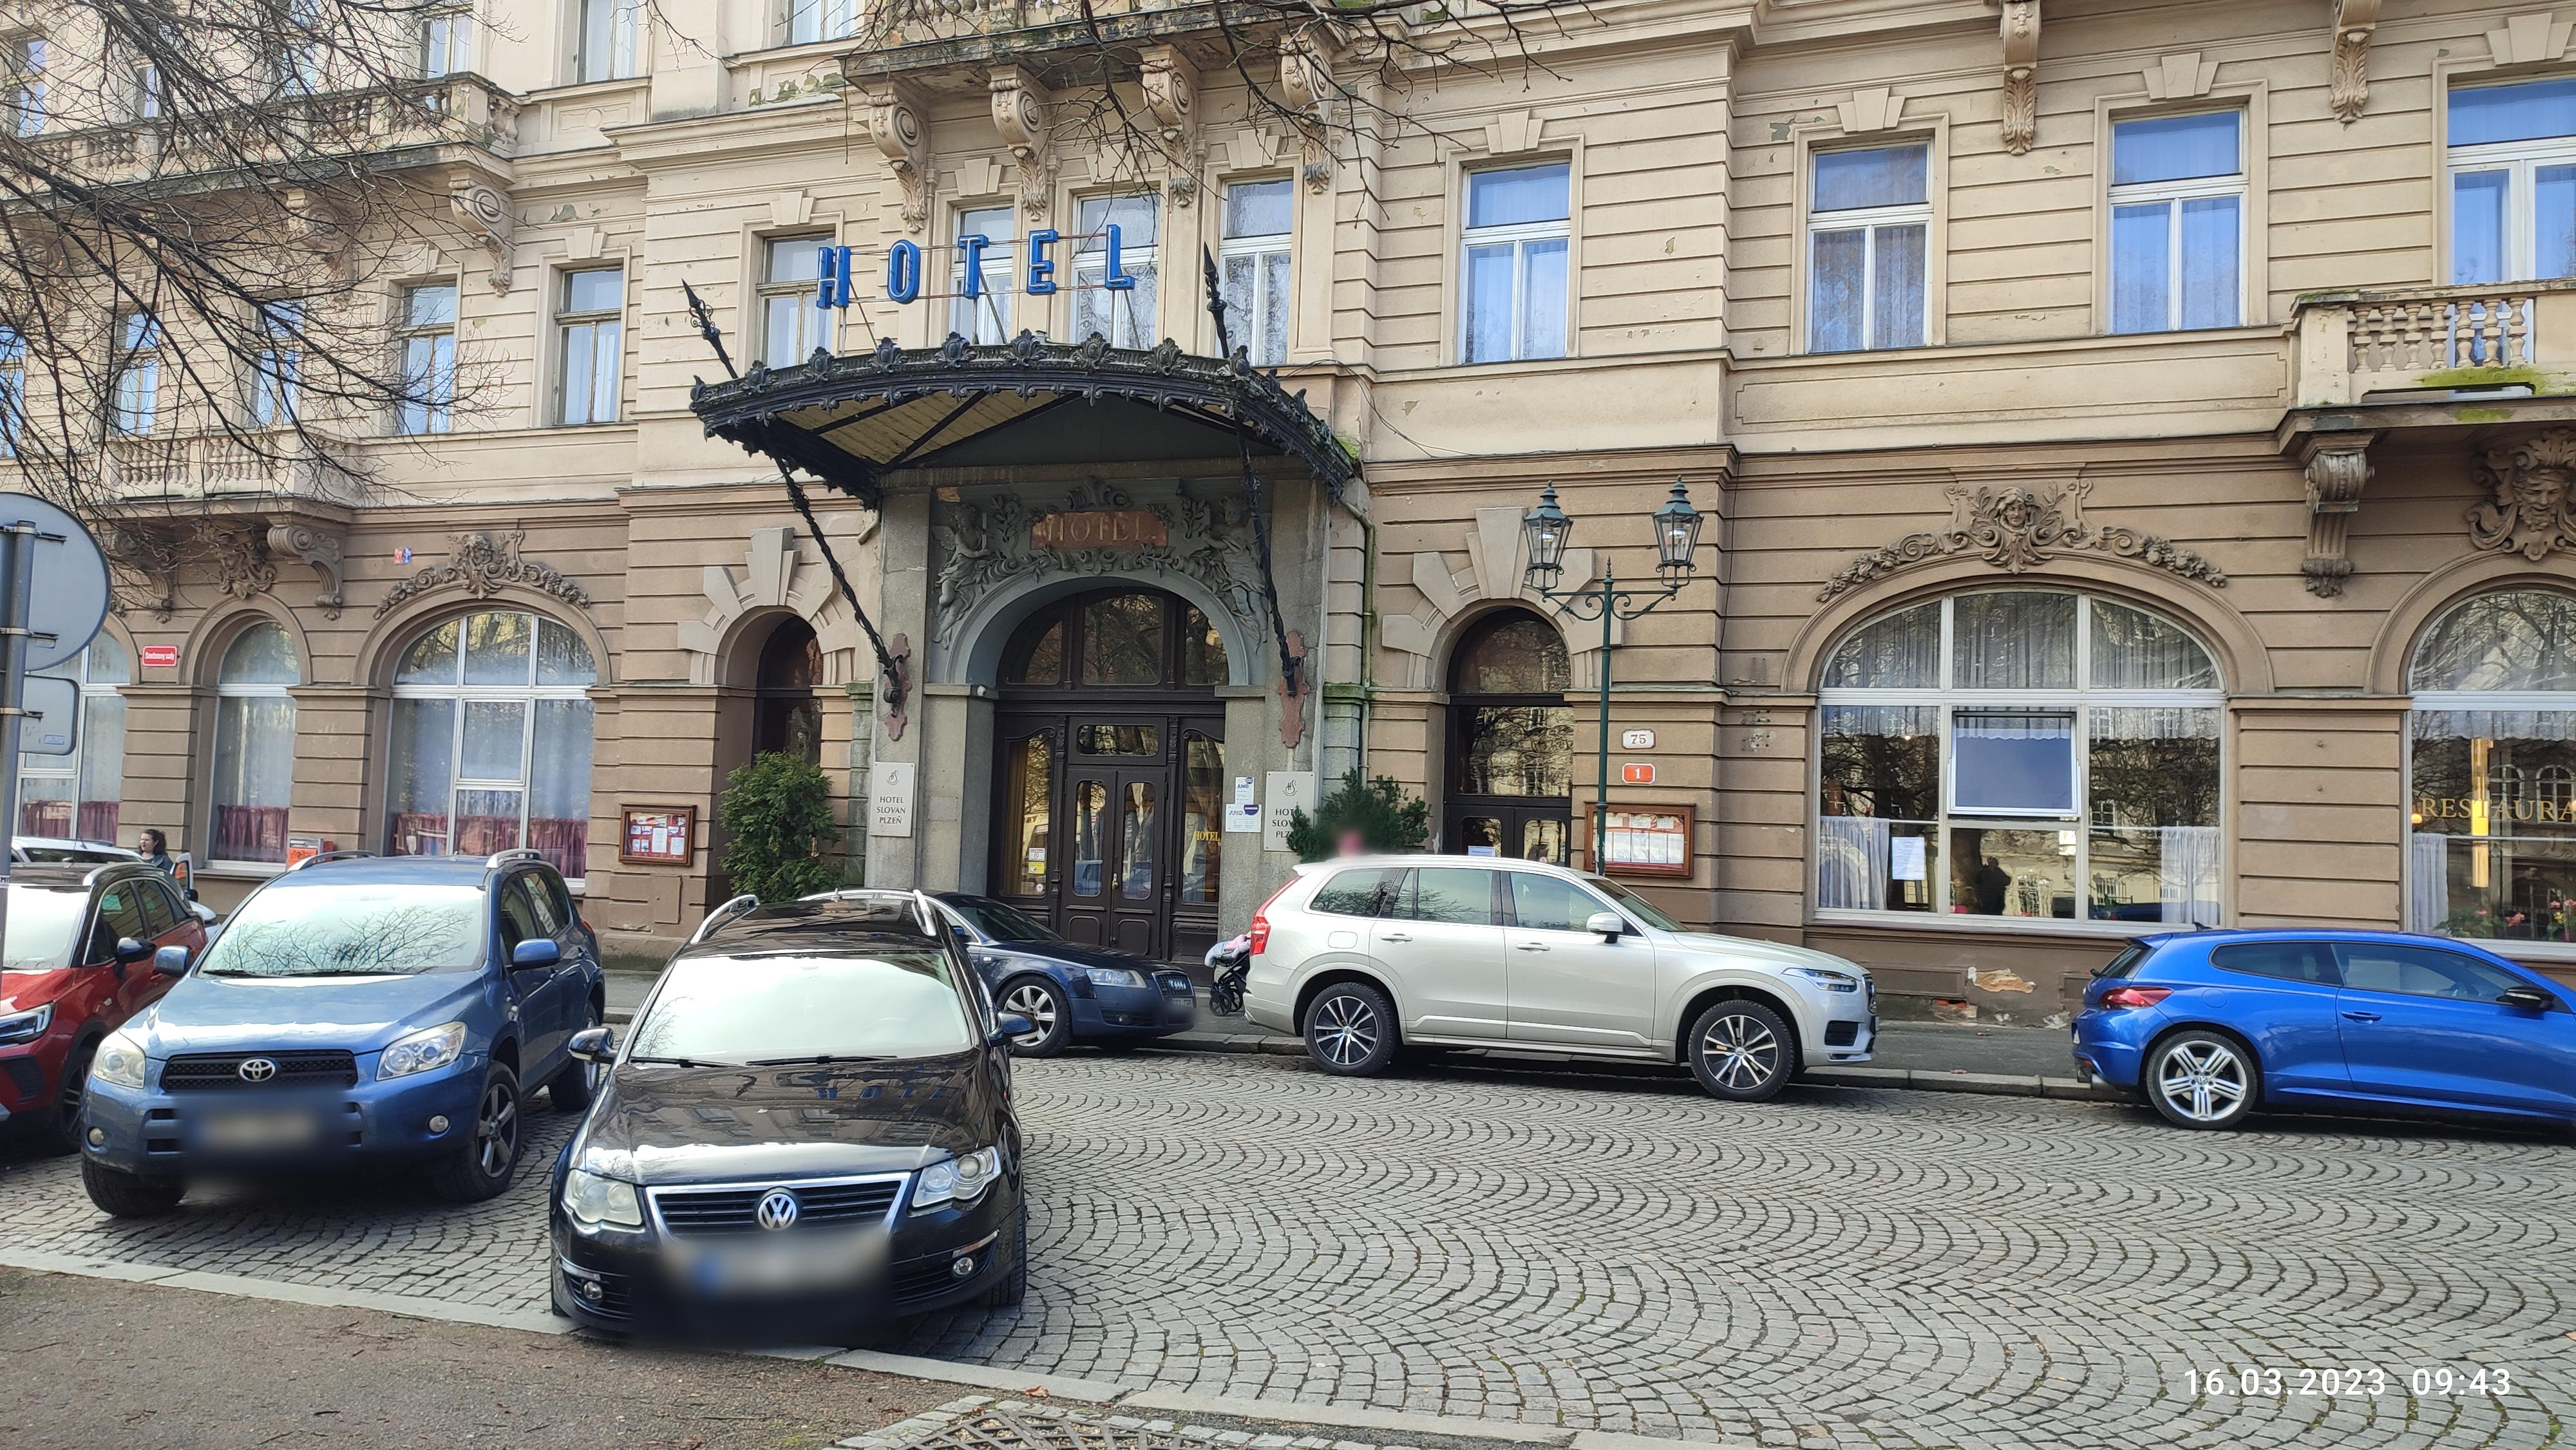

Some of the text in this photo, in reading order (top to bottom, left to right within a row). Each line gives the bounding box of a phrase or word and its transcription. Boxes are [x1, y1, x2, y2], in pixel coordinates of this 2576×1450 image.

[816, 223, 1135, 310] HOTEL
[1631, 734, 1647, 744] 75
[1634, 767, 1642, 779] 1
[879, 816, 902, 824] PLZEŇ
[1195, 831, 1220, 841] HOTEL
